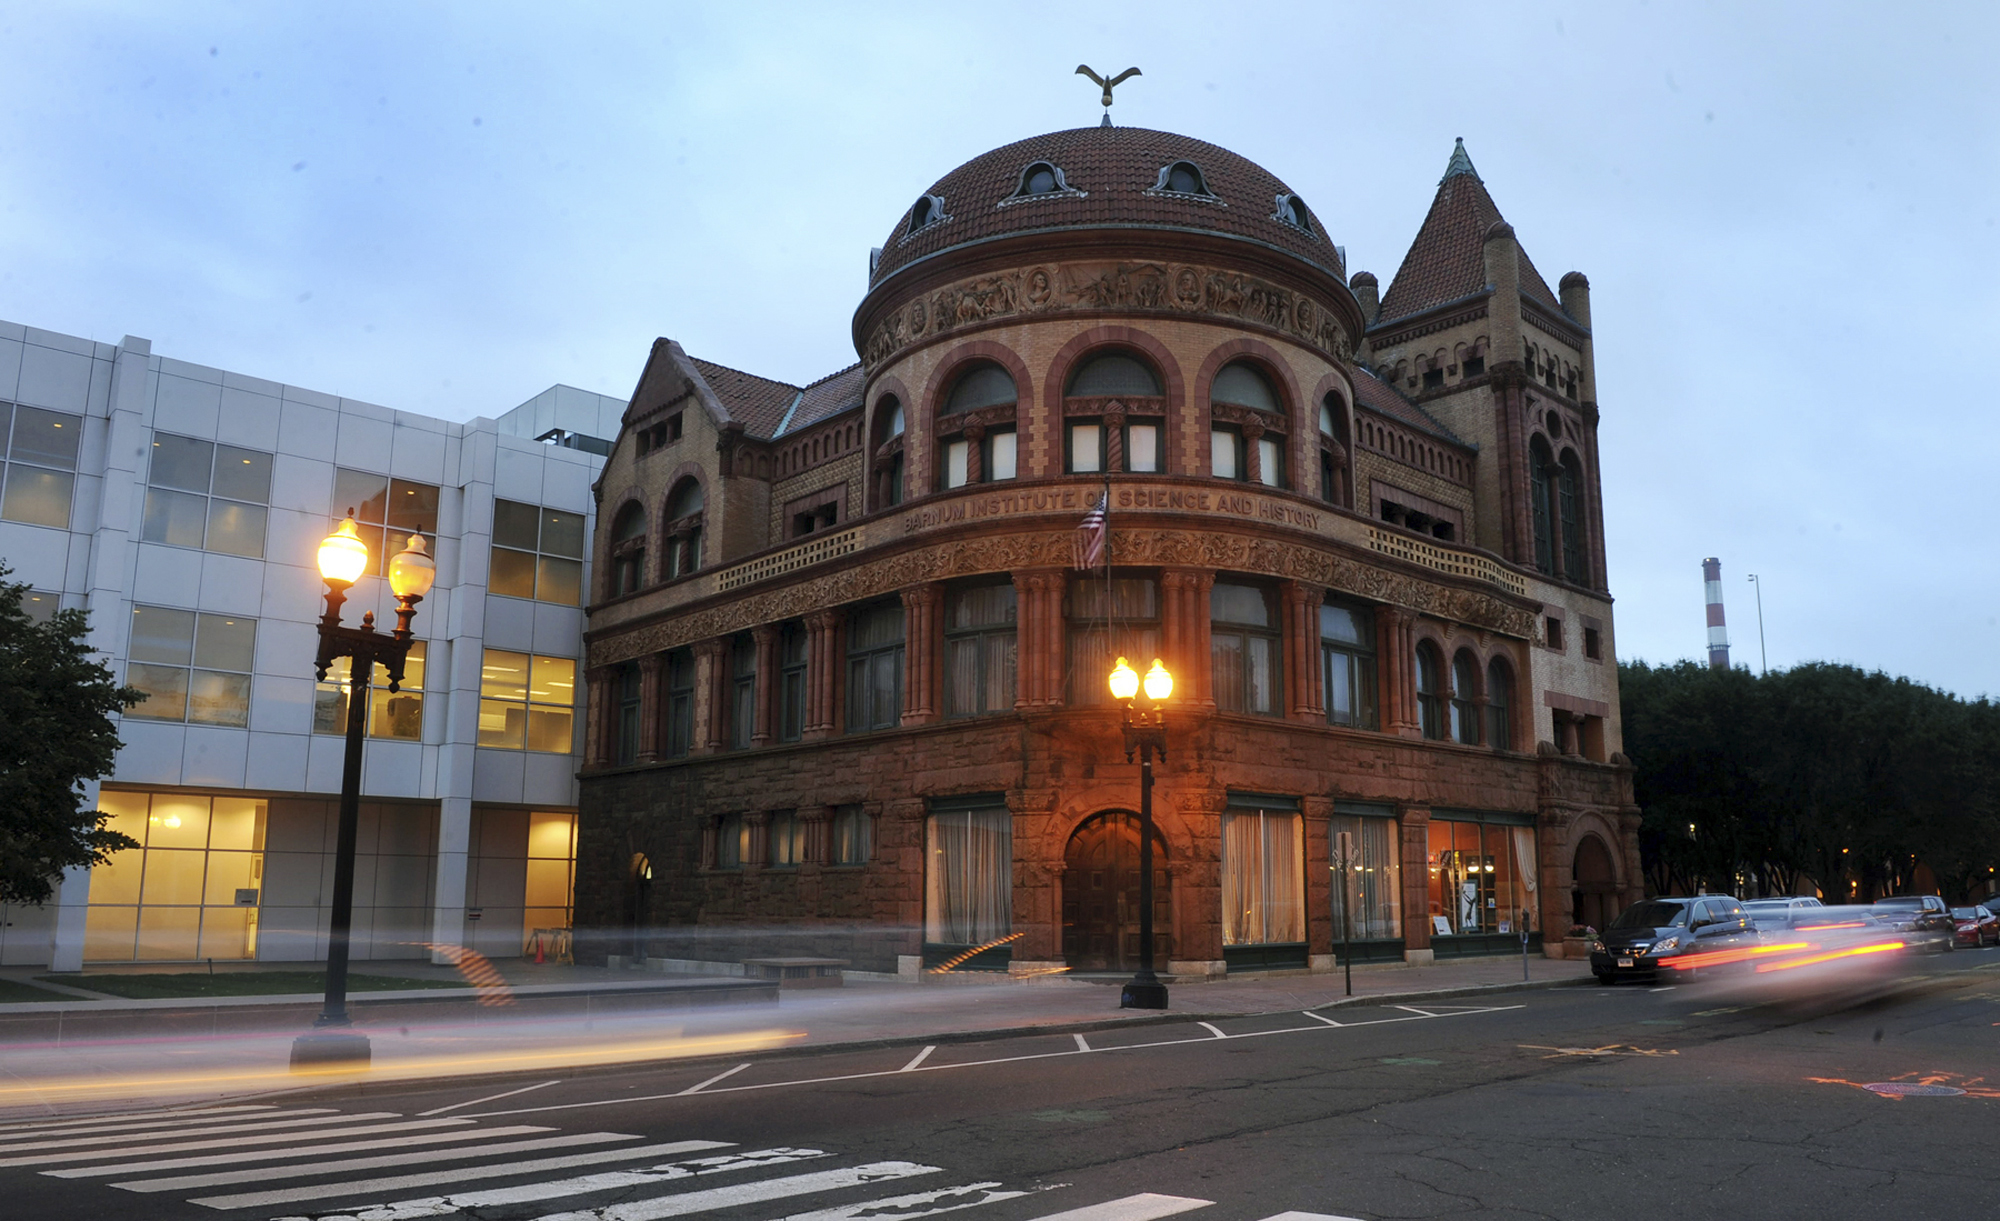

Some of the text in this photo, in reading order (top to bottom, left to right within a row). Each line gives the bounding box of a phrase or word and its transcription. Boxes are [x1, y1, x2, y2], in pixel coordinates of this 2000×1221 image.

[904, 502, 966, 533] BARNUM
[970, 490, 1076, 518] INSTITUTE
[1118, 490, 1210, 510] SCIENCE
[1216, 494, 1252, 515] AND
[1258, 500, 1321, 530] HISTORY
